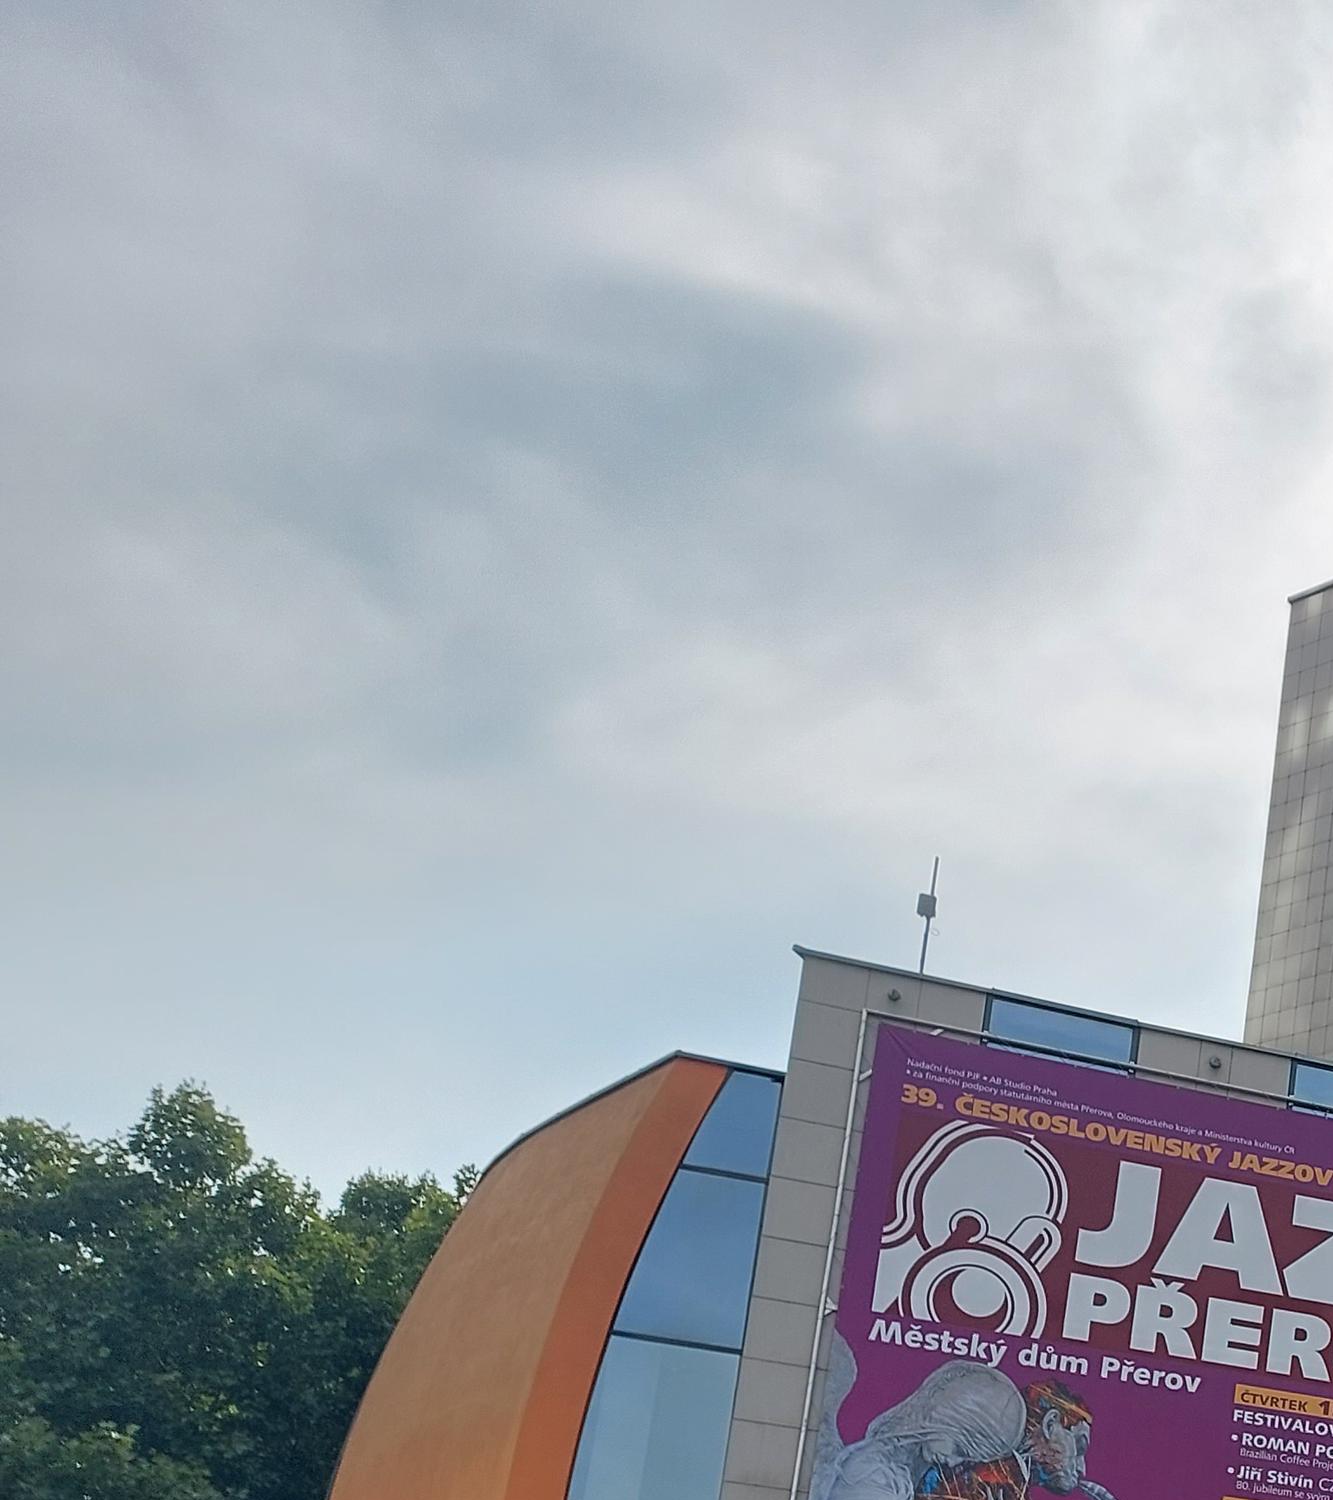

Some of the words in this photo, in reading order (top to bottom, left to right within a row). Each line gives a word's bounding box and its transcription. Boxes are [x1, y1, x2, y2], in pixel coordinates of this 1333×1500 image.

[907, 1058, 942, 1072] Nadační
[944, 1065, 964, 1077] fond
[1004, 1078, 1031, 1091] Studio
[1033, 1084, 1057, 1097] Praha
[913, 1071, 923, 1079] za
[925, 1070, 960, 1086] finanční
[962, 1081, 998, 1095] podpory
[1000, 1088, 1051, 1105] statutárního
[1054, 1100, 1079, 1111] města
[1081, 1104, 1114, 1118] Přerova,
[1117, 1112, 1174, 1130] Olomouckého
[1176, 1124, 1195, 1136] kraje
[1205, 1130, 1252, 1146] Ministerstva
[1254, 1138, 1283, 1153] kultury
[901, 1083, 944, 1110] 39.
[955, 1093, 1222, 1165] ČESKOSLOVENSKÝ
[868, 1318, 1007, 1367] Městský
[1018, 1343, 1088, 1375] dům
[1100, 1356, 1201, 1392] Přerov
[1241, 1389, 1307, 1412] ČTVRTEK
[1242, 1433, 1309, 1455] ROMAN
[1240, 1449, 1277, 1461] Brazilian
[1280, 1454, 1310, 1466] Coffee
[1237, 1466, 1261, 1481] Jiří
[1267, 1470, 1313, 1489] Stivín
[1236, 1481, 1250, 1491] 80.
[1252, 1482, 1292, 1498] jubileum
[1294, 1490, 1304, 1498] se
